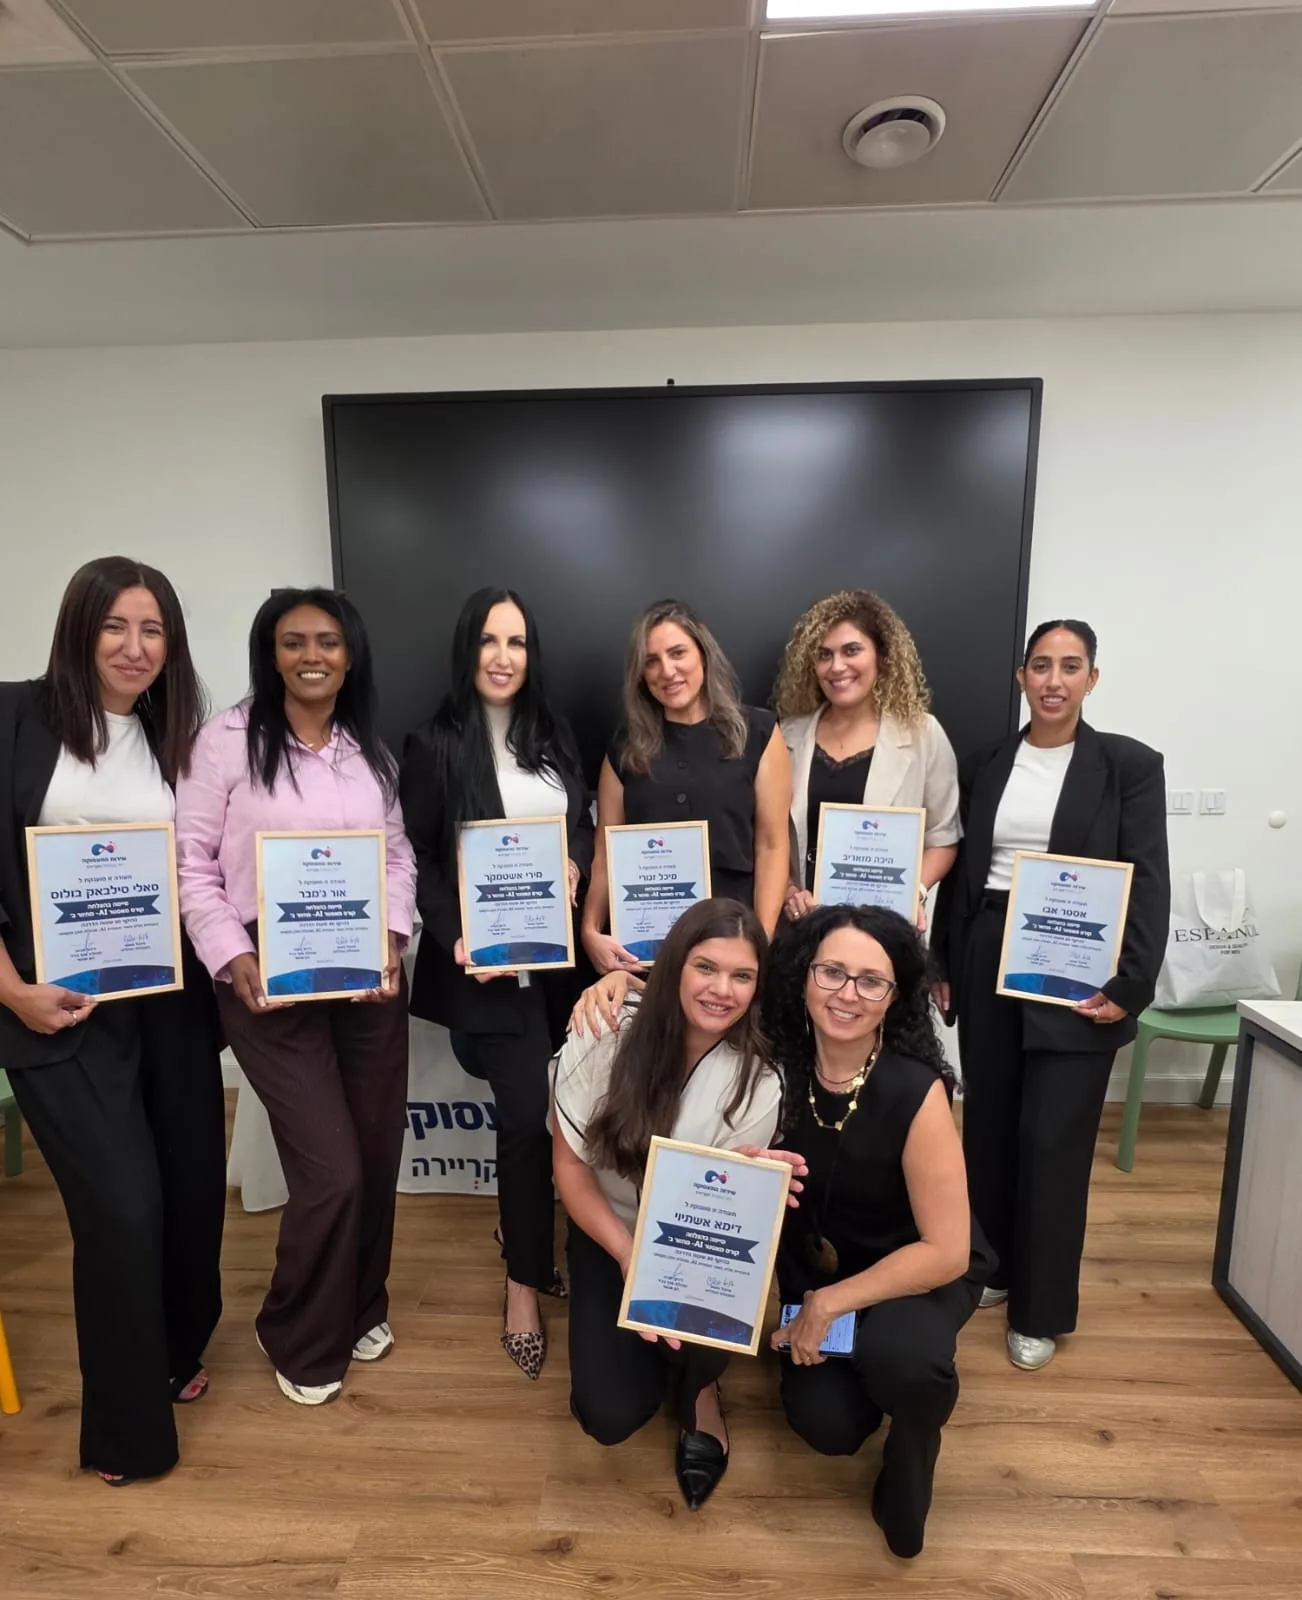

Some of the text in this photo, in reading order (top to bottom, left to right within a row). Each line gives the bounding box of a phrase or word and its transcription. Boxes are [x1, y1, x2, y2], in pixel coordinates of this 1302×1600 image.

[51, 883, 159, 899] סאלי סילבאק בולוס
[407, 1102, 498, 1140] עסוק
[714, 1221, 742, 1233] דימא
